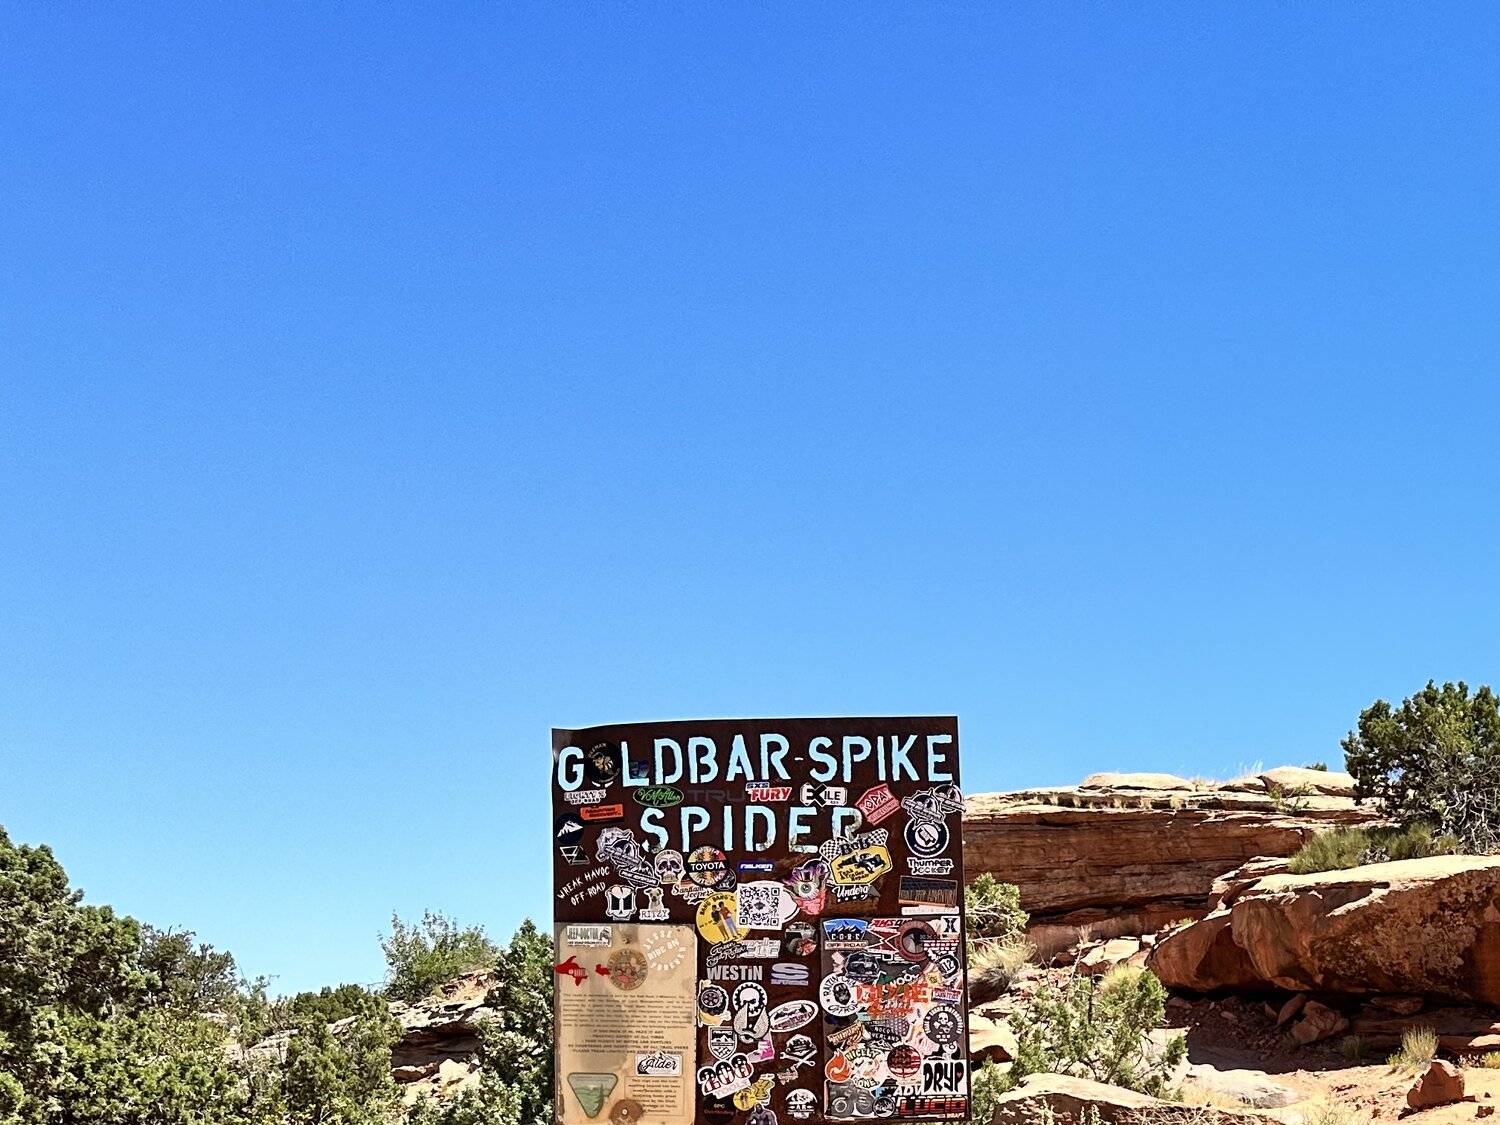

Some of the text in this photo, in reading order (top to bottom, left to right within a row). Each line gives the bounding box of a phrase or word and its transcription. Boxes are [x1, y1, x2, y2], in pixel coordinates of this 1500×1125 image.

[557, 733, 954, 791] GLDBAR-SPIKE
[751, 787, 792, 802] FURY
[640, 805, 863, 853] SPIDER
[690, 862, 725, 872] TOYOTA
[557, 877, 584, 899] WREAK
[584, 866, 611, 881] HAVOC
[845, 1047, 880, 1061] NICELY
[642, 1060, 677, 1071] Alder
